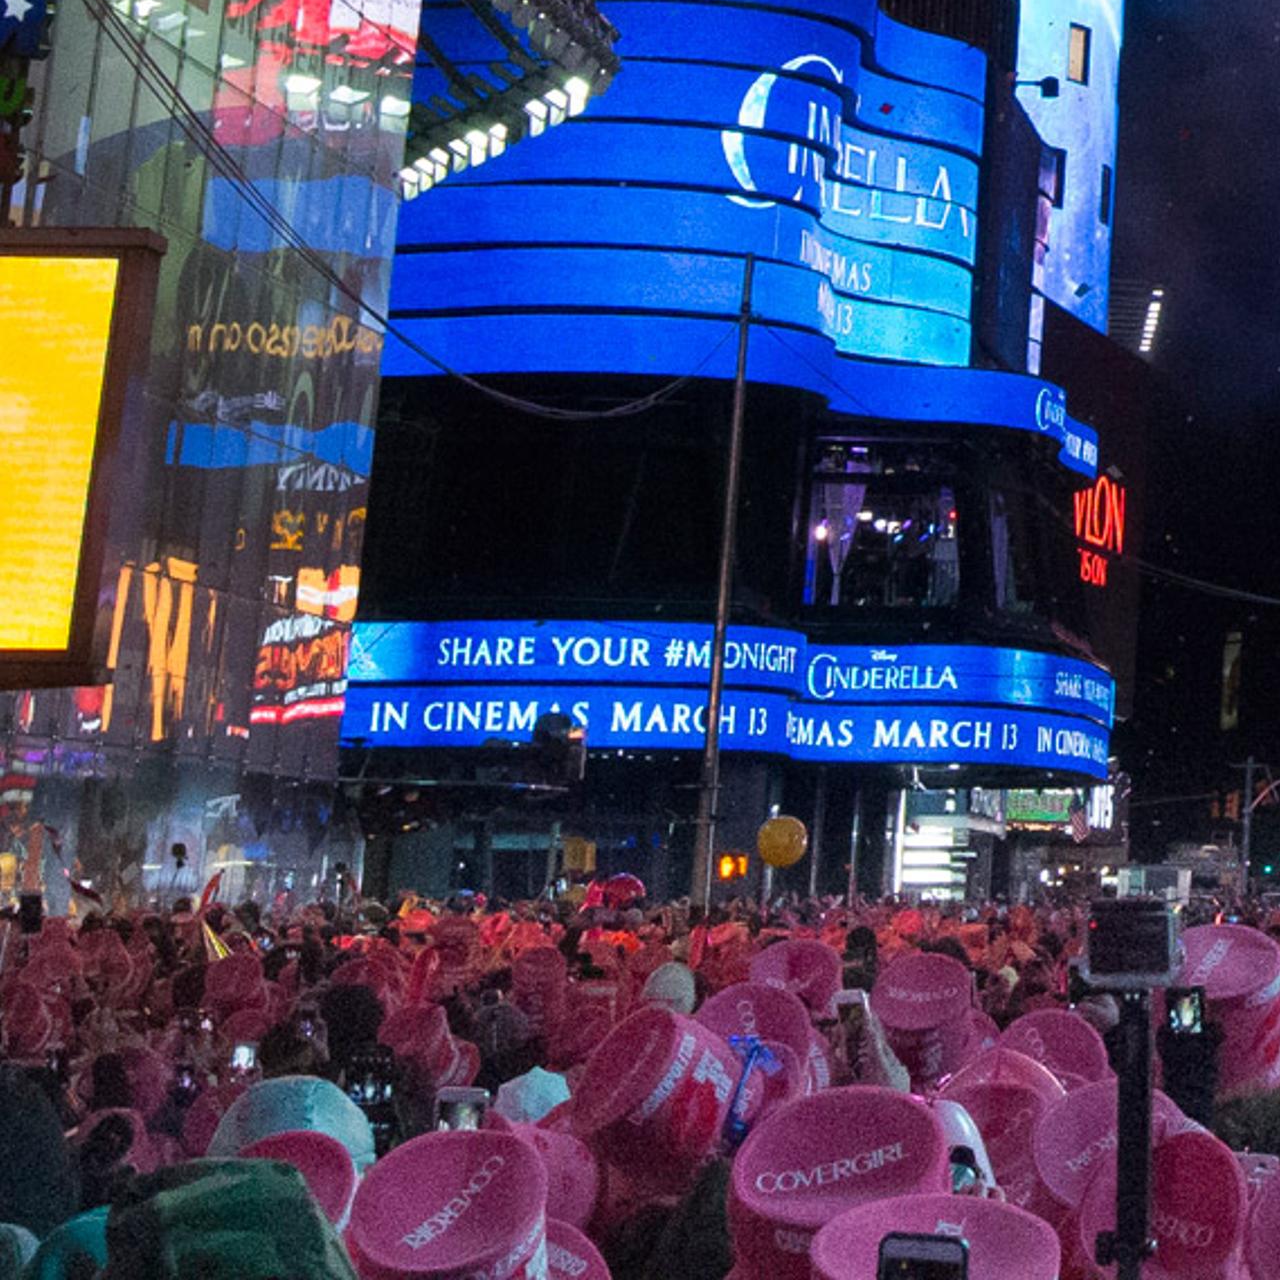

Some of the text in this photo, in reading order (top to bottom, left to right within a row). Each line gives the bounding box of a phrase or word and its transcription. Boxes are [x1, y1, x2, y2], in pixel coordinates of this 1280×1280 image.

[437, 636, 798, 675] SHARE YOUR #MDNIGHT
[807, 653, 958, 700] CINDERELLA
[370, 701, 409, 732] IN
[611, 701, 736, 734] MARCH
[749, 707, 768, 736] 13
[873, 720, 992, 750] MARCH
[1001, 722, 1018, 751] 13
[1037, 725, 1054, 753] IN
[755, 1142, 908, 1194] COVERGIRL
